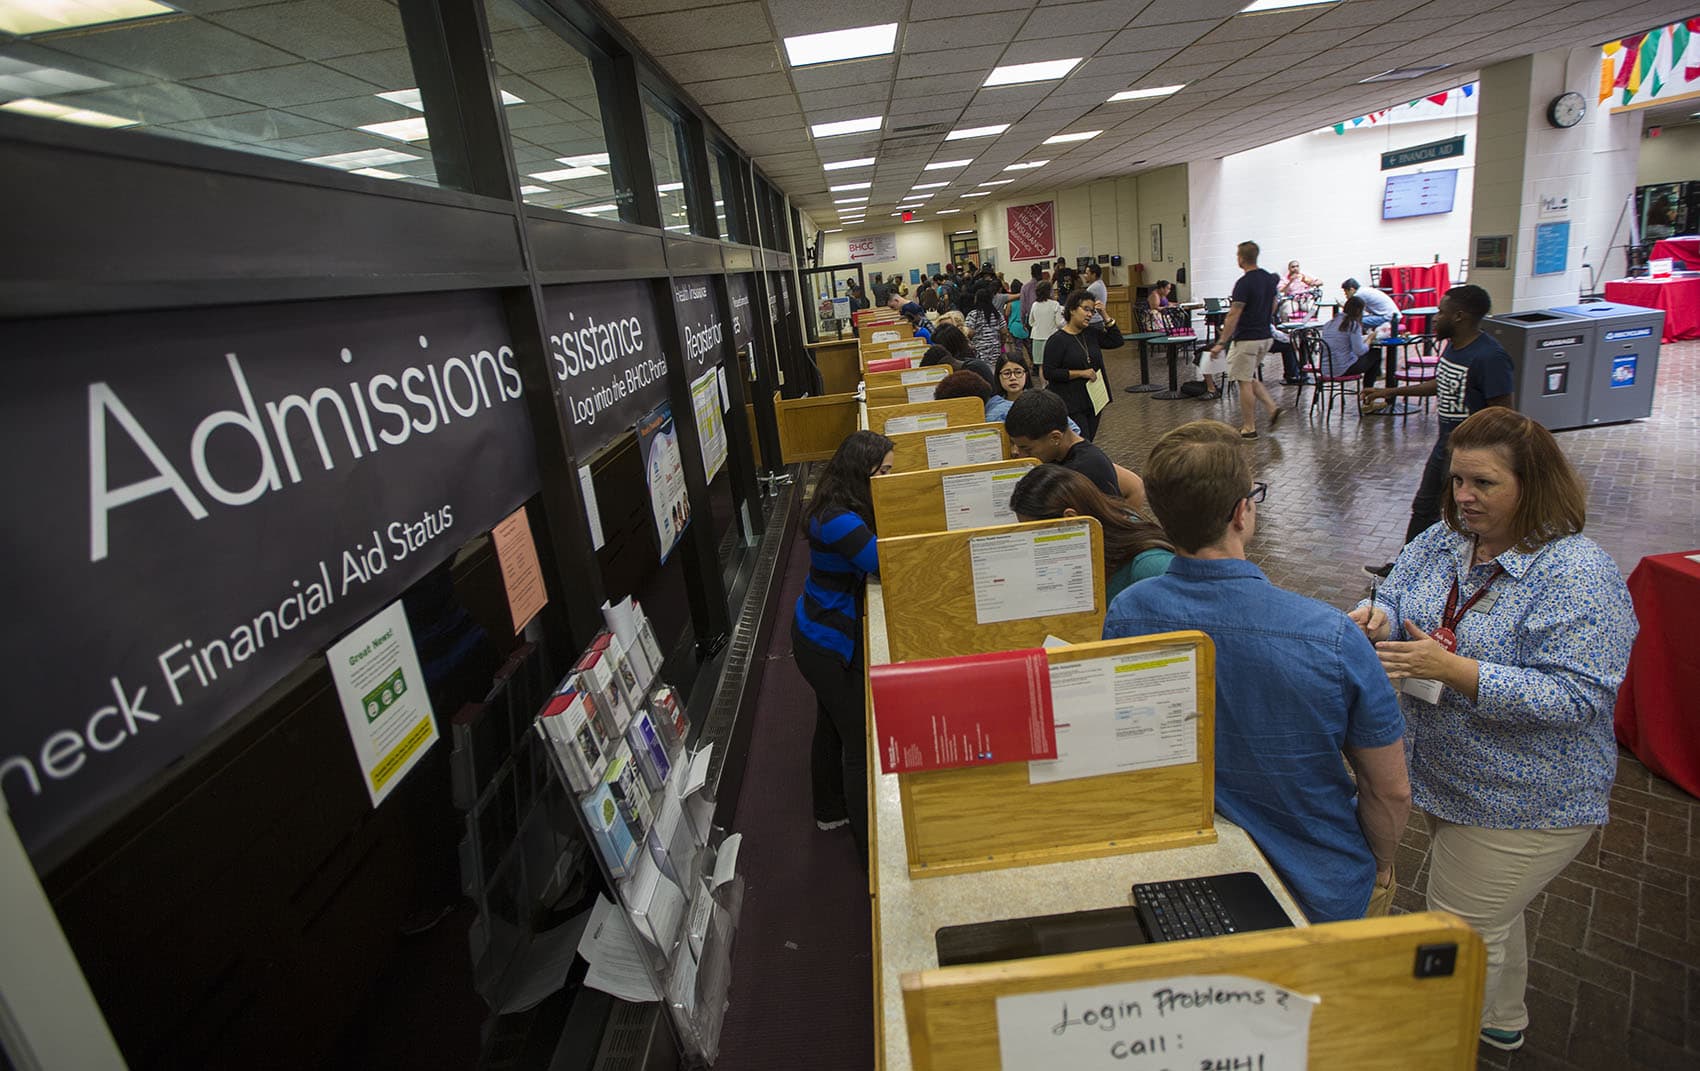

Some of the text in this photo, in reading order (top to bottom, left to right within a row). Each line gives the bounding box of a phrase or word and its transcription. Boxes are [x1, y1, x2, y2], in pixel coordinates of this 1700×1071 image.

[1012, 221, 1047, 255] INSURANCE
[1018, 213, 1043, 238] HEALTH
[849, 242, 874, 252] BHCC
[569, 396, 595, 425] Log
[612, 374, 627, 401] the
[625, 361, 651, 394] BHCC
[648, 352, 668, 381] Portal
[89, 334, 523, 562] Admissions
[158, 561, 334, 705] Financial
[341, 530, 388, 596] Aid
[387, 504, 453, 561] Status
[348, 644, 372, 666] Great
[1051, 1000, 1142, 1035] Login
[1152, 987, 1266, 1017] Problems
